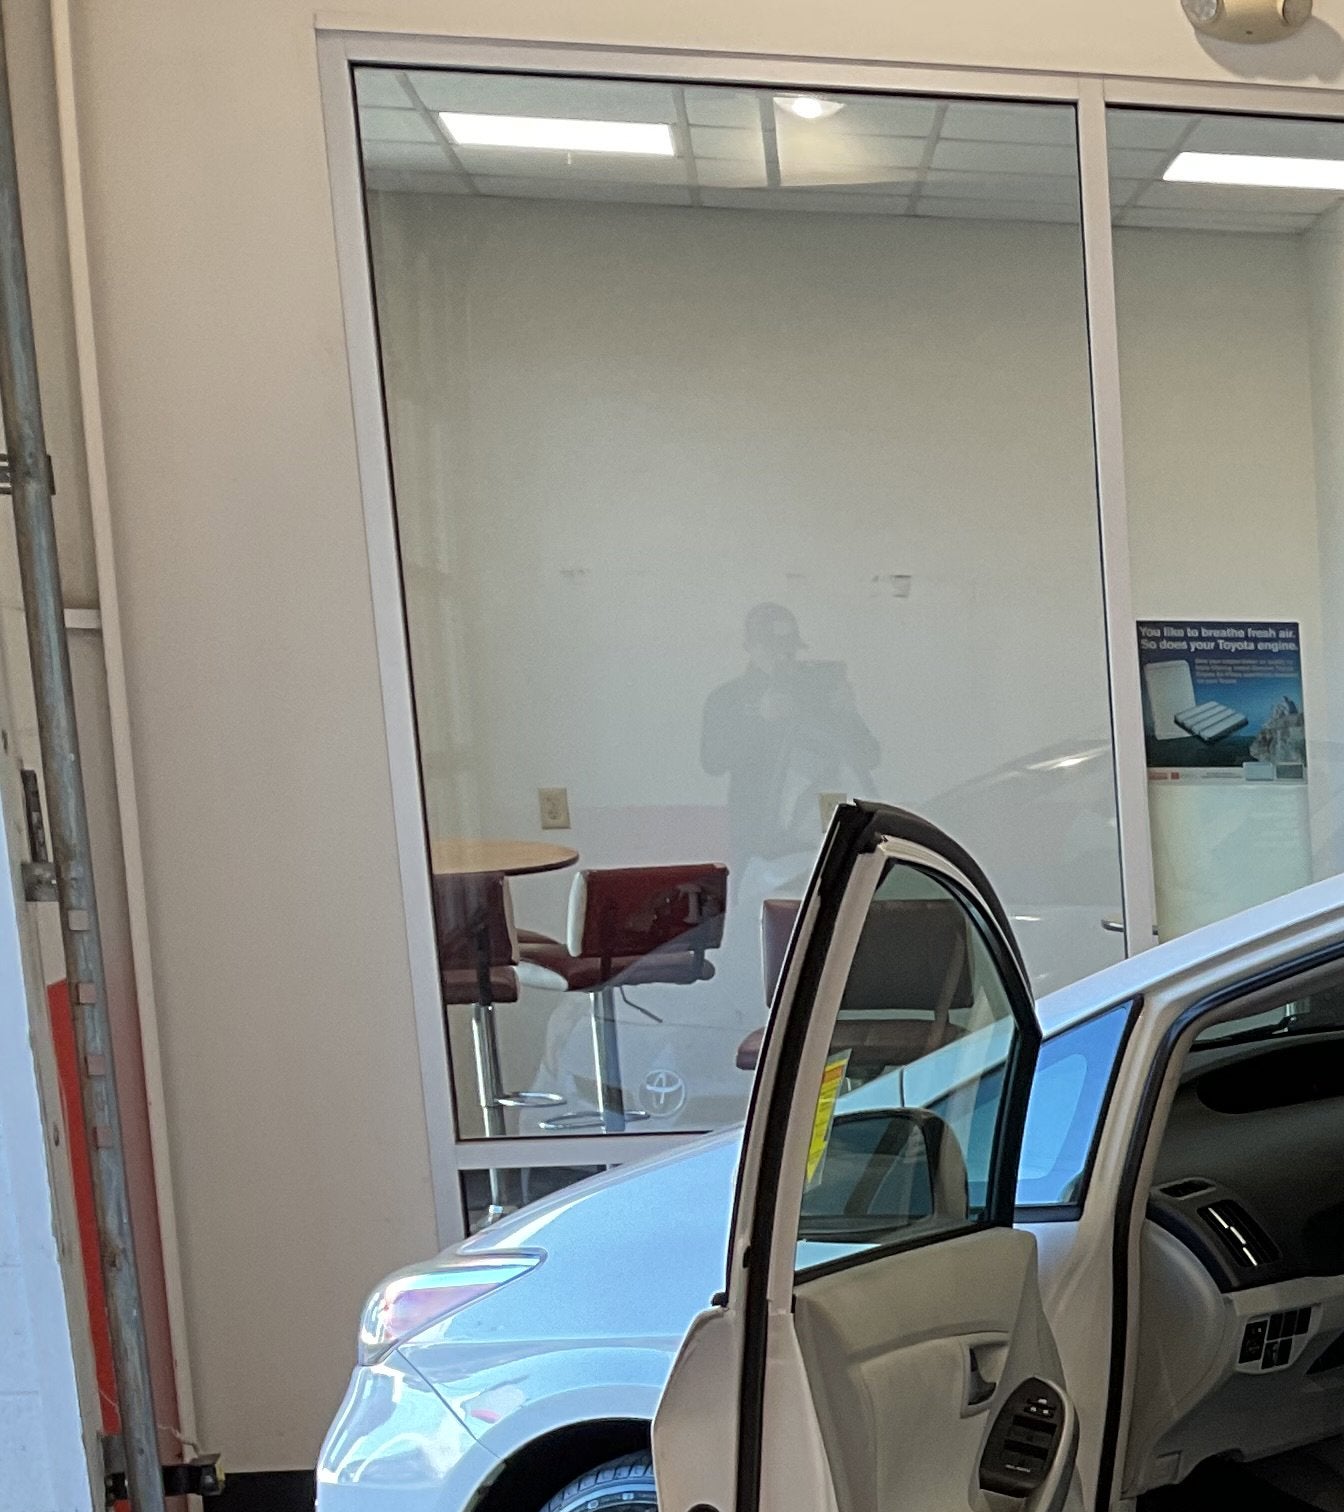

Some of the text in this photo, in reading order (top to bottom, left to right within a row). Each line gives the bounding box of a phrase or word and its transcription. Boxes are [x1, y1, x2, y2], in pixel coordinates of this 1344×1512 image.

[1139, 626, 1296, 639] You like to breathe fresh air.
[1140, 639, 1299, 653] So does your Toyota engine.
